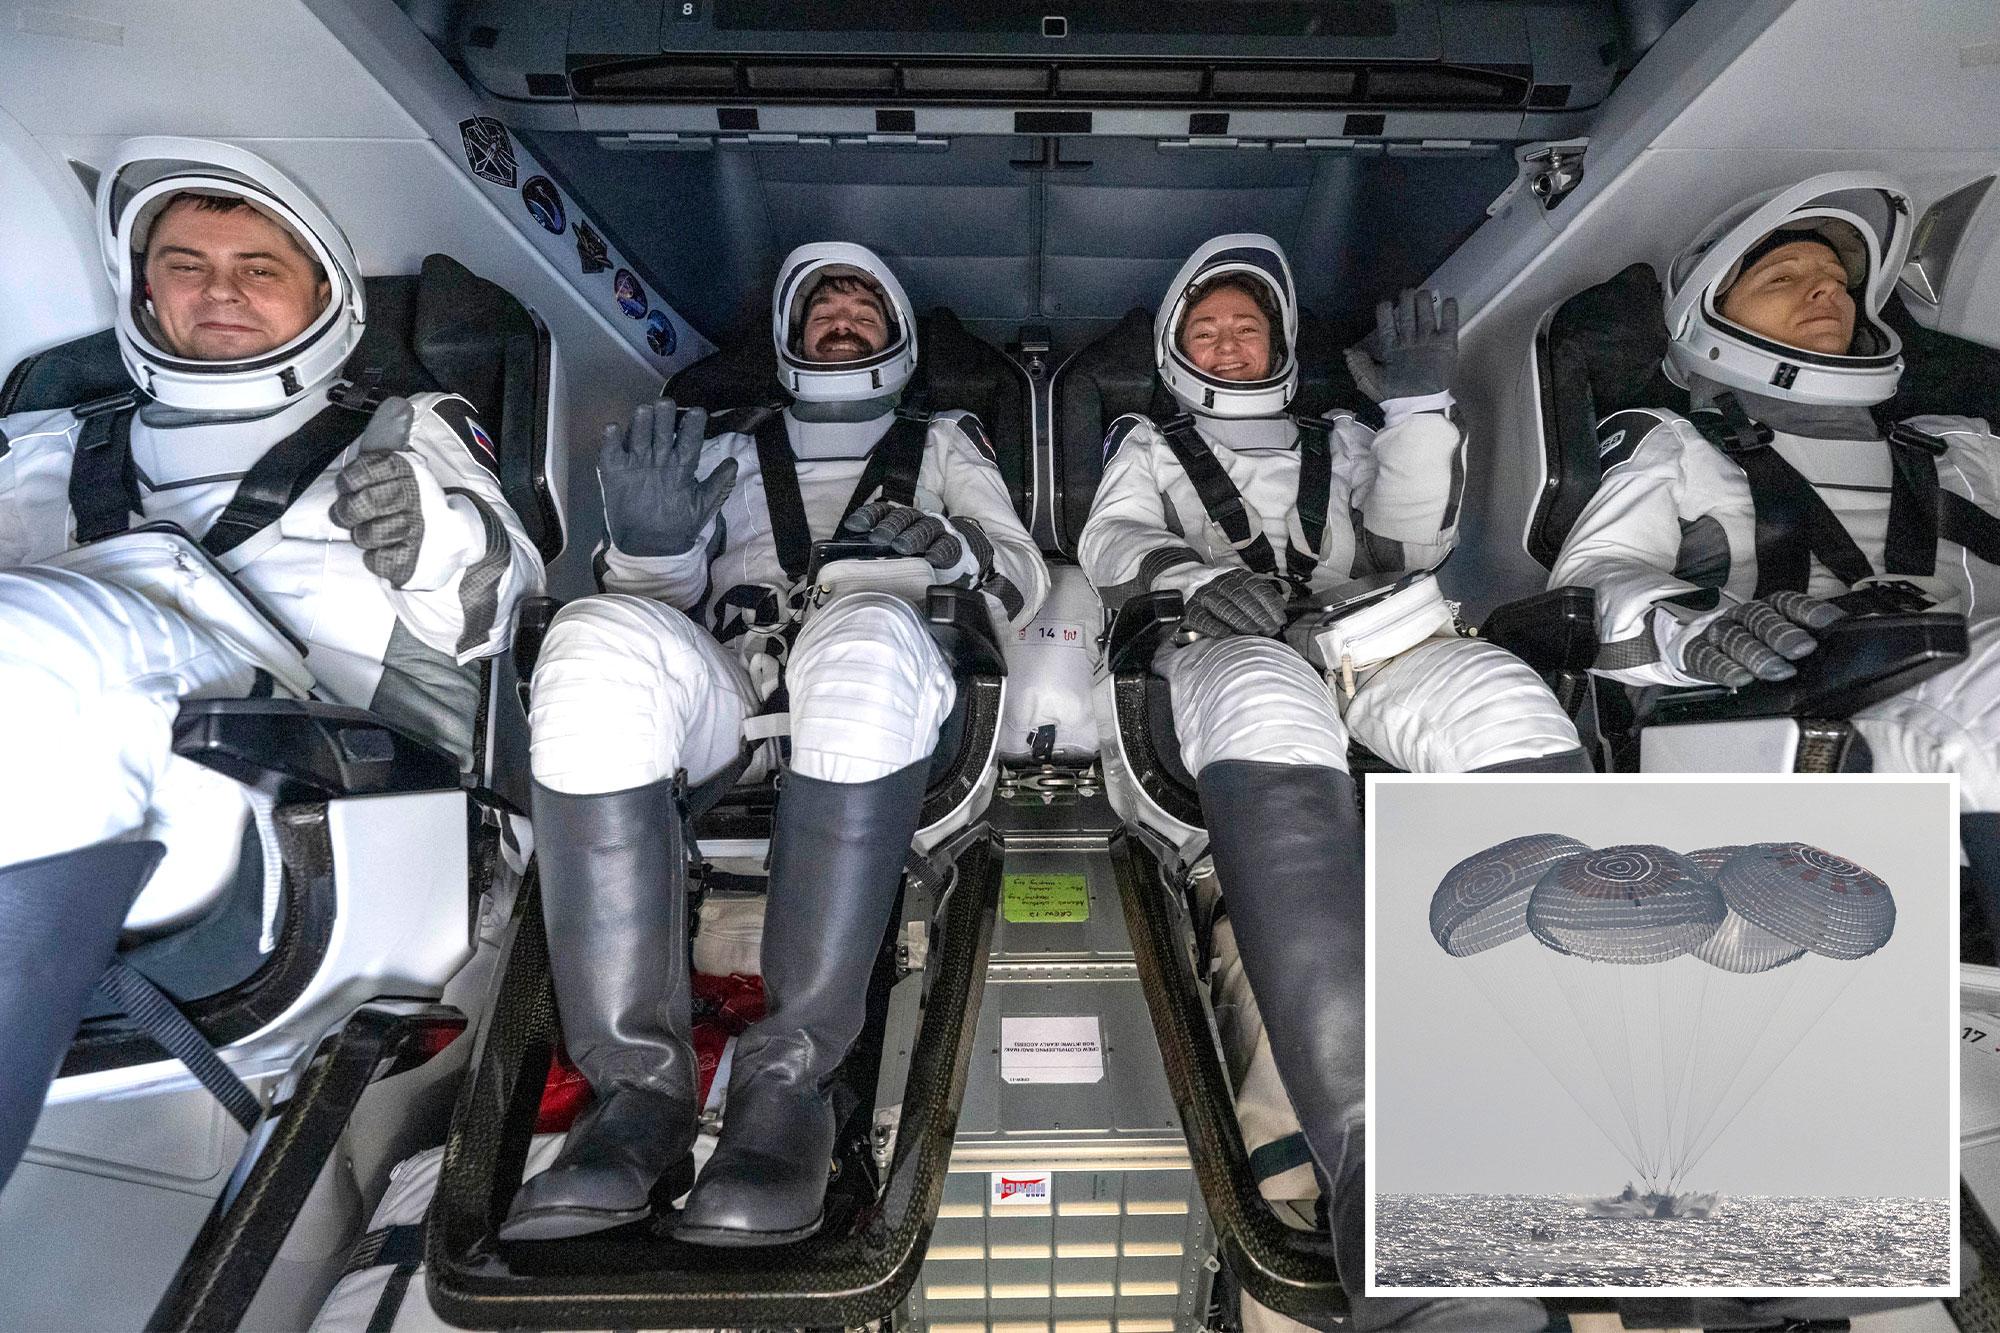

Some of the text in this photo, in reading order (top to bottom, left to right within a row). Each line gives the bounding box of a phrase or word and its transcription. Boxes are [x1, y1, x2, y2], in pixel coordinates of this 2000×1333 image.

[683, 3, 693, 15] 8
[1039, 627, 1055, 638] 14
[1962, 1027, 1987, 1042] 17
[996, 1183, 1046, 1193] HUNCH
